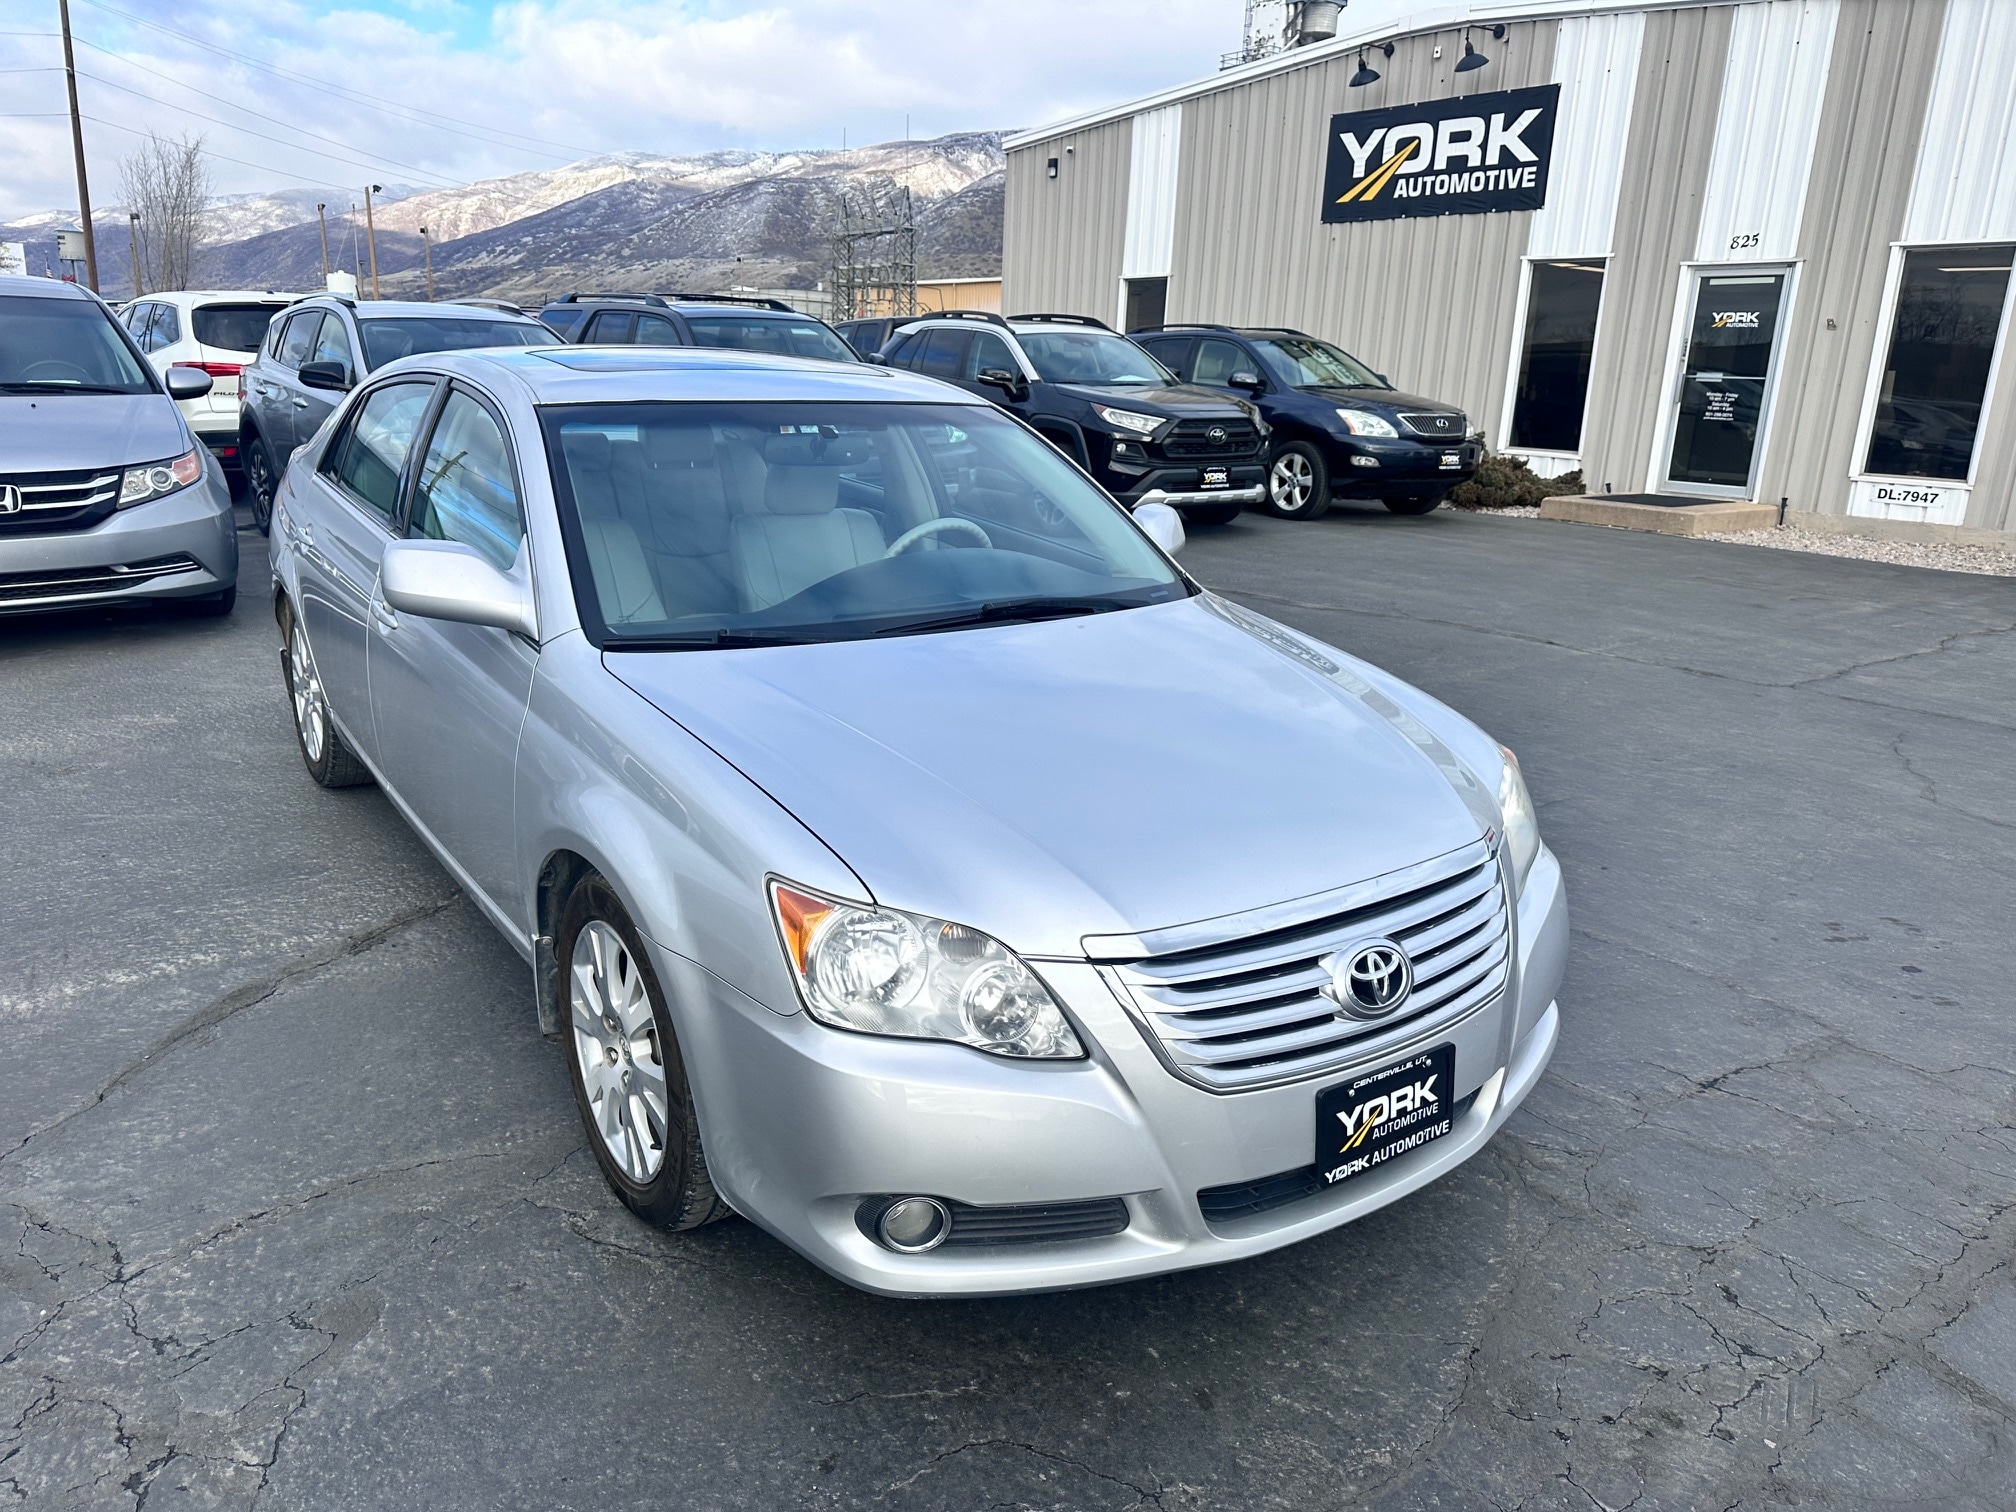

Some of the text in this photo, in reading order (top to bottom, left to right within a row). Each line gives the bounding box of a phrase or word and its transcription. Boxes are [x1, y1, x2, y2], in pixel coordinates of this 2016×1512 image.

[1339, 108, 1543, 178] YORK
[1393, 166, 1537, 198] AUTOMOTIVE
[1730, 233, 1760, 249] 825
[1712, 312, 1759, 322] YORK
[1204, 472, 1227, 480] YORK
[1877, 488, 1939, 504] DL:7947
[1353, 1055, 1427, 1089] CENTERVILLE, UT
[1336, 1073, 1438, 1137] YORK
[1372, 1102, 1439, 1140] AUTOMOTIVE
[1325, 1119, 1450, 1184] YORK AUTOMOTIVE
